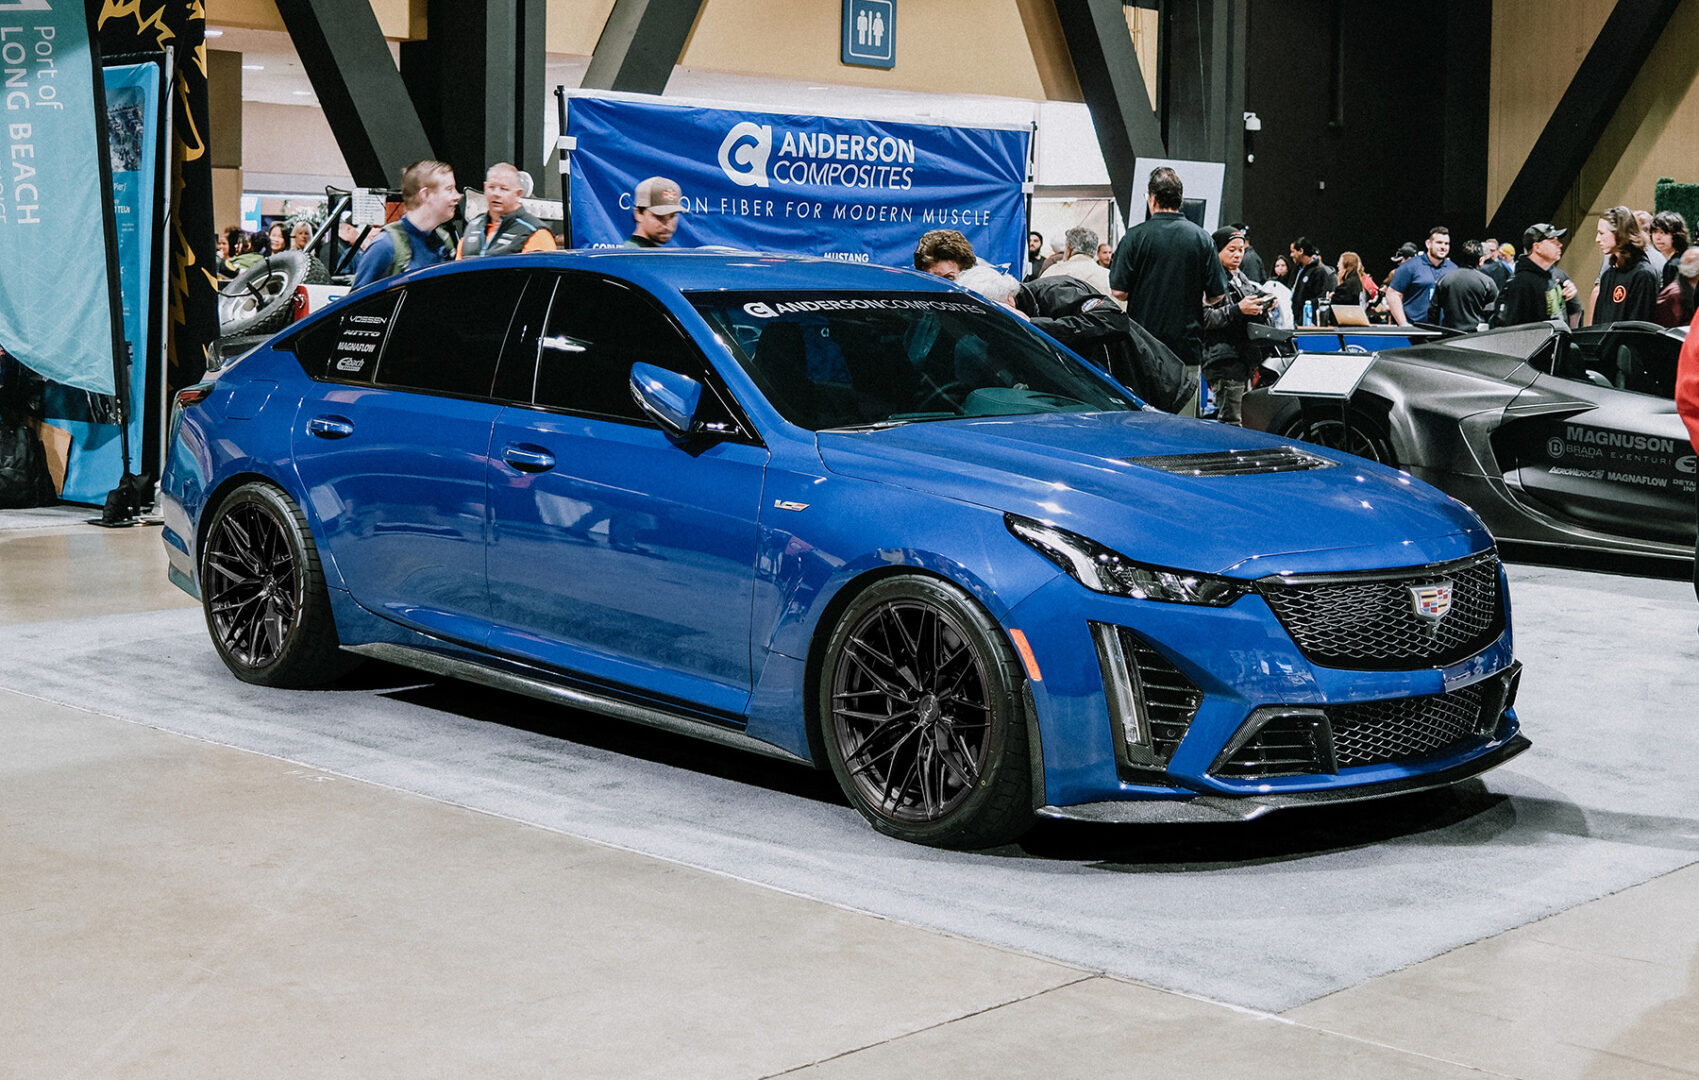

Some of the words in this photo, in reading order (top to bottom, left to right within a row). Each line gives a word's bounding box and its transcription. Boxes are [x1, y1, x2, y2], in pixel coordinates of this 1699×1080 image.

[33, 26, 58, 79] Port
[0, 26, 31, 110] LONG
[35, 85, 64, 111] of
[778, 131, 916, 164] ANDERSON
[9, 123, 41, 225] BEACH
[773, 160, 914, 191] COMPOSITES
[619, 192, 708, 214] CON
[721, 197, 774, 217] FIBER
[785, 201, 822, 219] FOR
[832, 203, 913, 223] MODERN
[922, 208, 991, 226] MUSCLE
[824, 252, 870, 264] MUSTANG
[343, 329, 381, 337] NITTO
[350, 315, 387, 324] VOSSEN
[1566, 425, 1674, 453] MAGNUSON
[1566, 444, 1603, 457] BRADA
[1607, 471, 1667, 487] MAGNAFLOW
